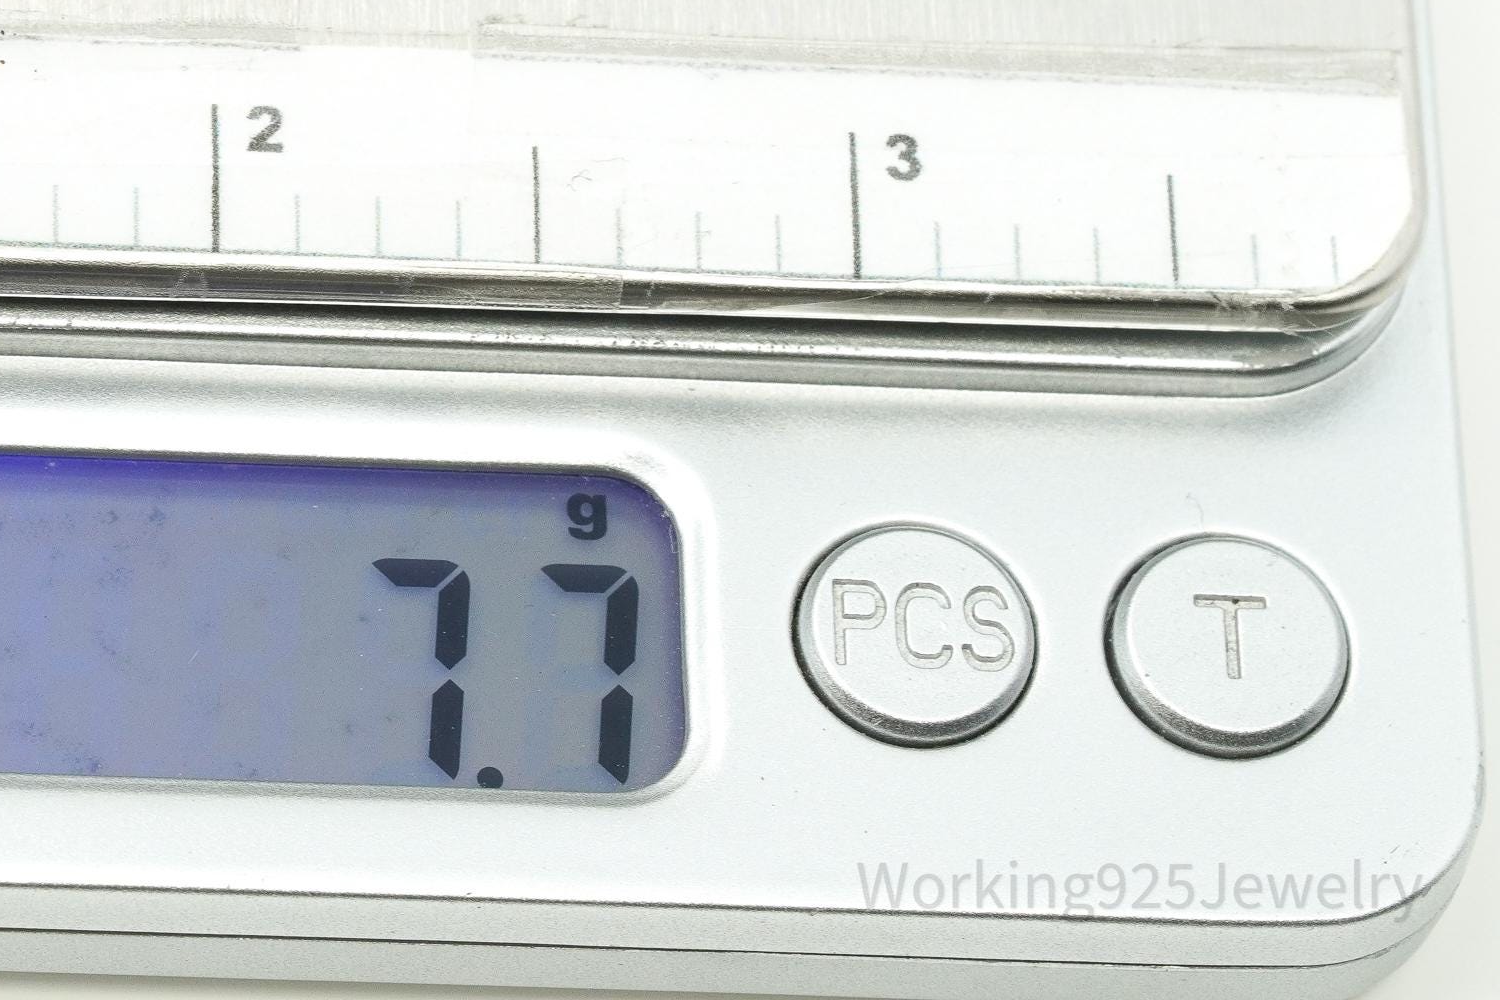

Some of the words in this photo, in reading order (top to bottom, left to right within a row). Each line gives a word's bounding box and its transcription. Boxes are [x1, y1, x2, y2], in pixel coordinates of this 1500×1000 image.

[245, 105, 285, 154] 2
[886, 134, 923, 182] 3
[565, 493, 608, 541] g
[831, 578, 1017, 673] PCS
[1192, 593, 1268, 680] T
[371, 557, 640, 788] 7.7
